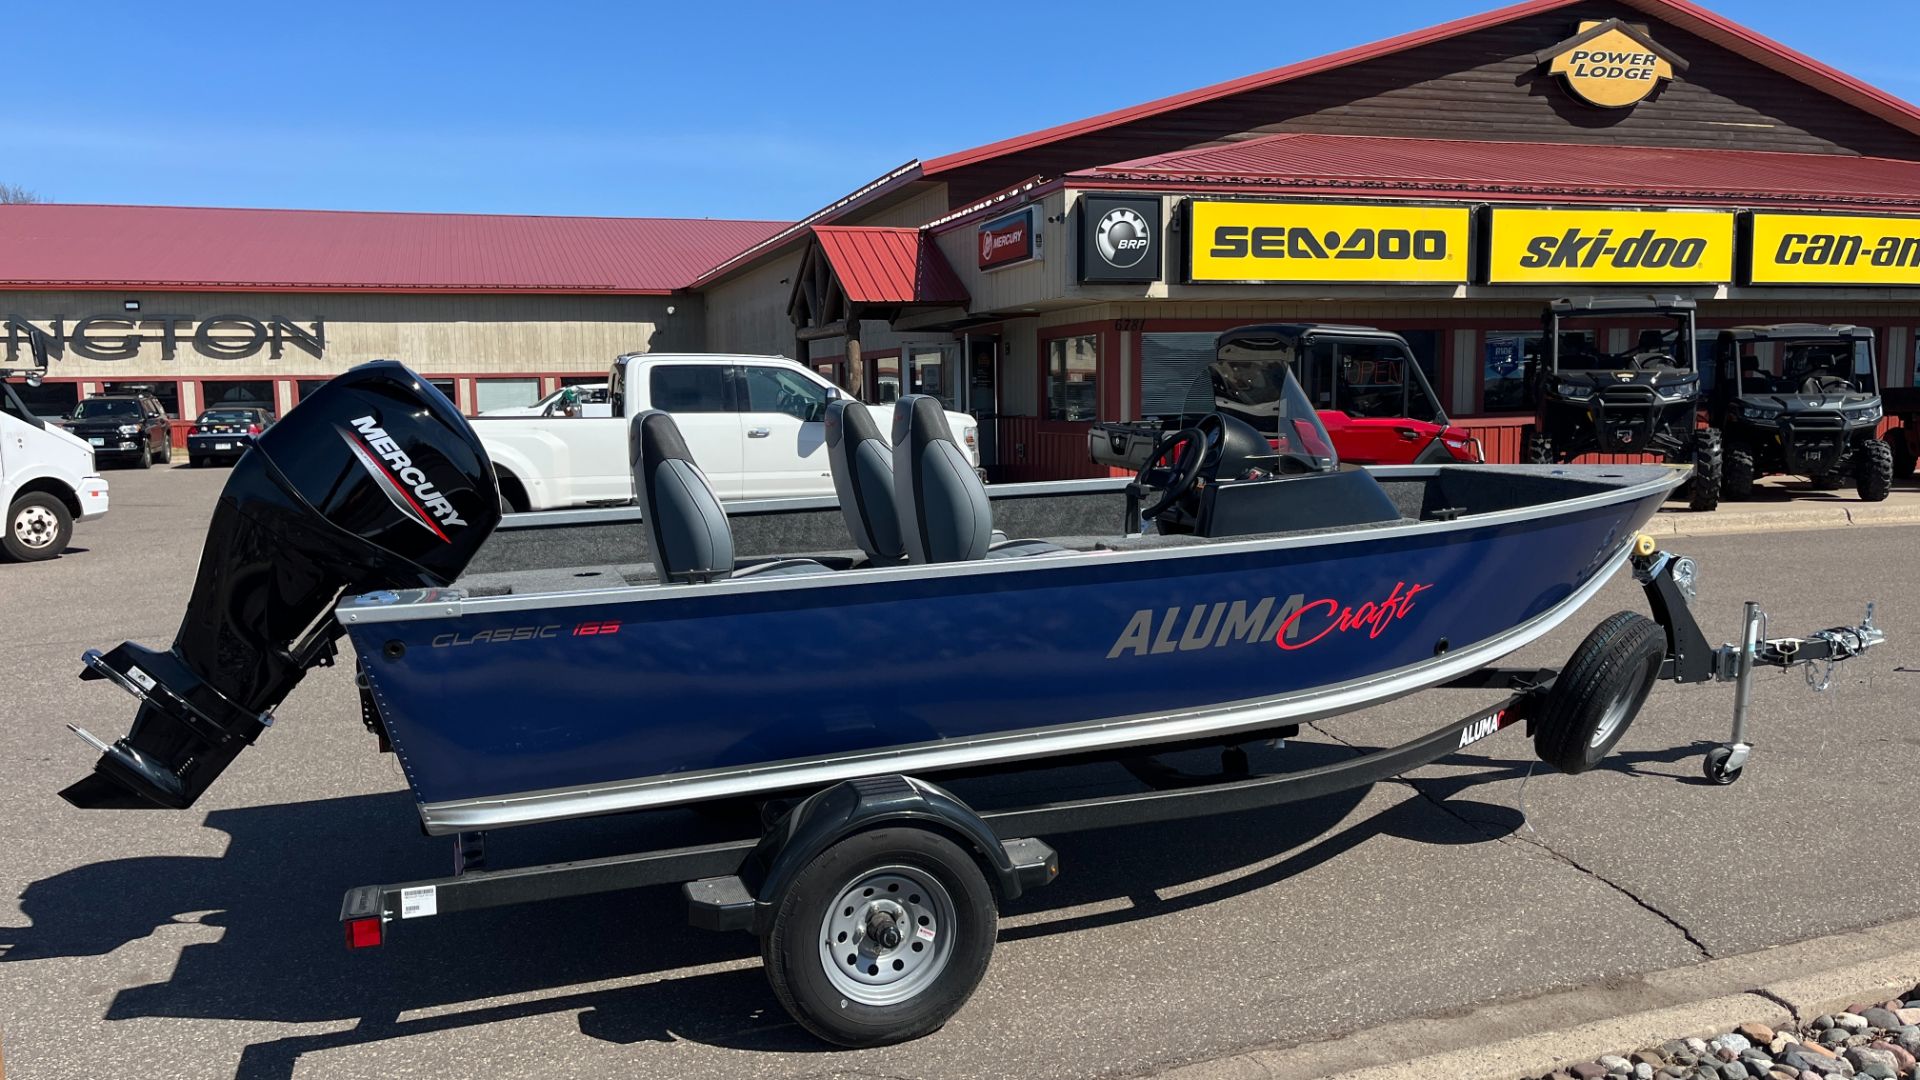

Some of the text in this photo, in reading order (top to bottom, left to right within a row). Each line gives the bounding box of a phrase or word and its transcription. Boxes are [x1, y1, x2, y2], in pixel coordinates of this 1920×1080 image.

[1570, 51, 1657, 66] POWER
[1574, 64, 1653, 80] LODGE
[993, 230, 1023, 249] MERCURY
[1117, 239, 1147, 250] BRP
[1519, 228, 1708, 268] ski-doo
[1347, 360, 1404, 384] OPEN
[350, 415, 468, 527] MERCURY
[432, 625, 561, 648] CLASSIC
